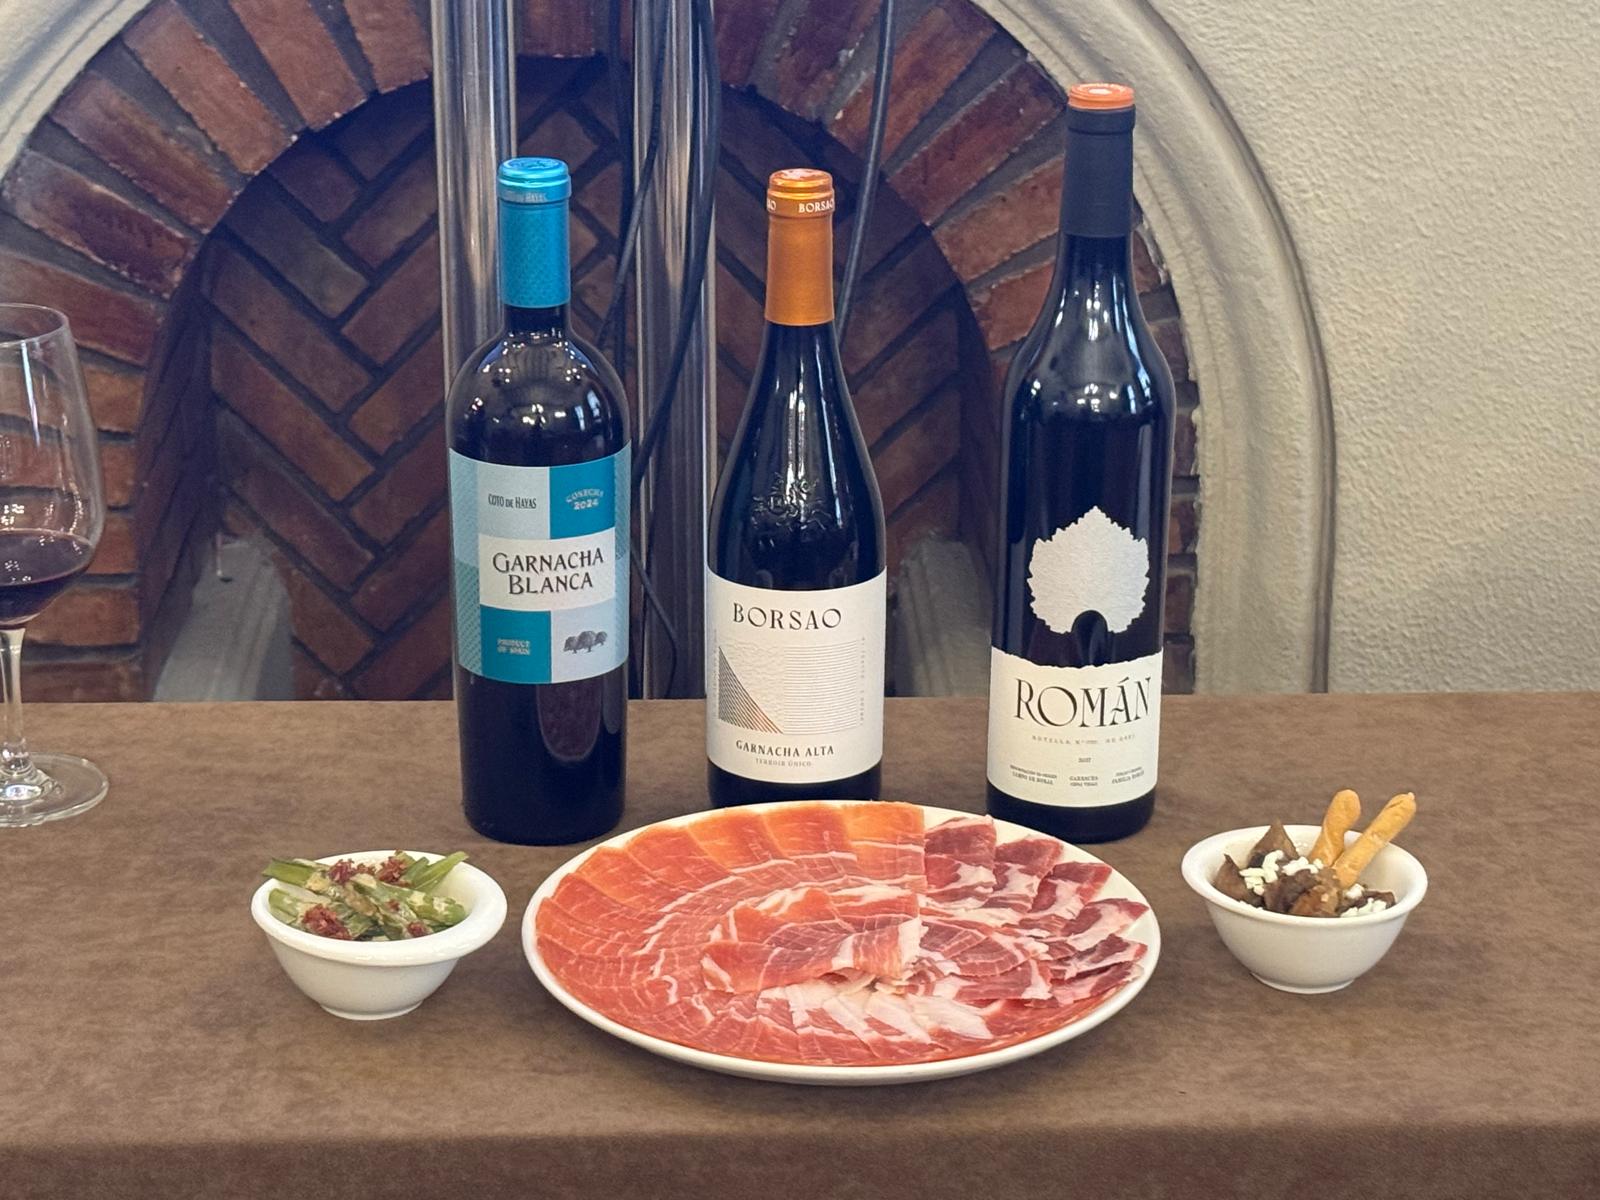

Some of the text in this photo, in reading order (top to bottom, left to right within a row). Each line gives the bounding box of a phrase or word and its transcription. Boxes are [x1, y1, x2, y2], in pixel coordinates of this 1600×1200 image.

[798, 198, 834, 213] BORSAO
[488, 493, 537, 509] COTO DE HAYAS
[492, 547, 604, 576] GARNACHA
[508, 571, 593, 595] BLANCA
[733, 602, 842, 631] BORSAO
[1014, 676, 1151, 728] ROMÁN
[736, 740, 834, 757] GARNACHA ALTA
[755, 757, 786, 767] TERROIR
